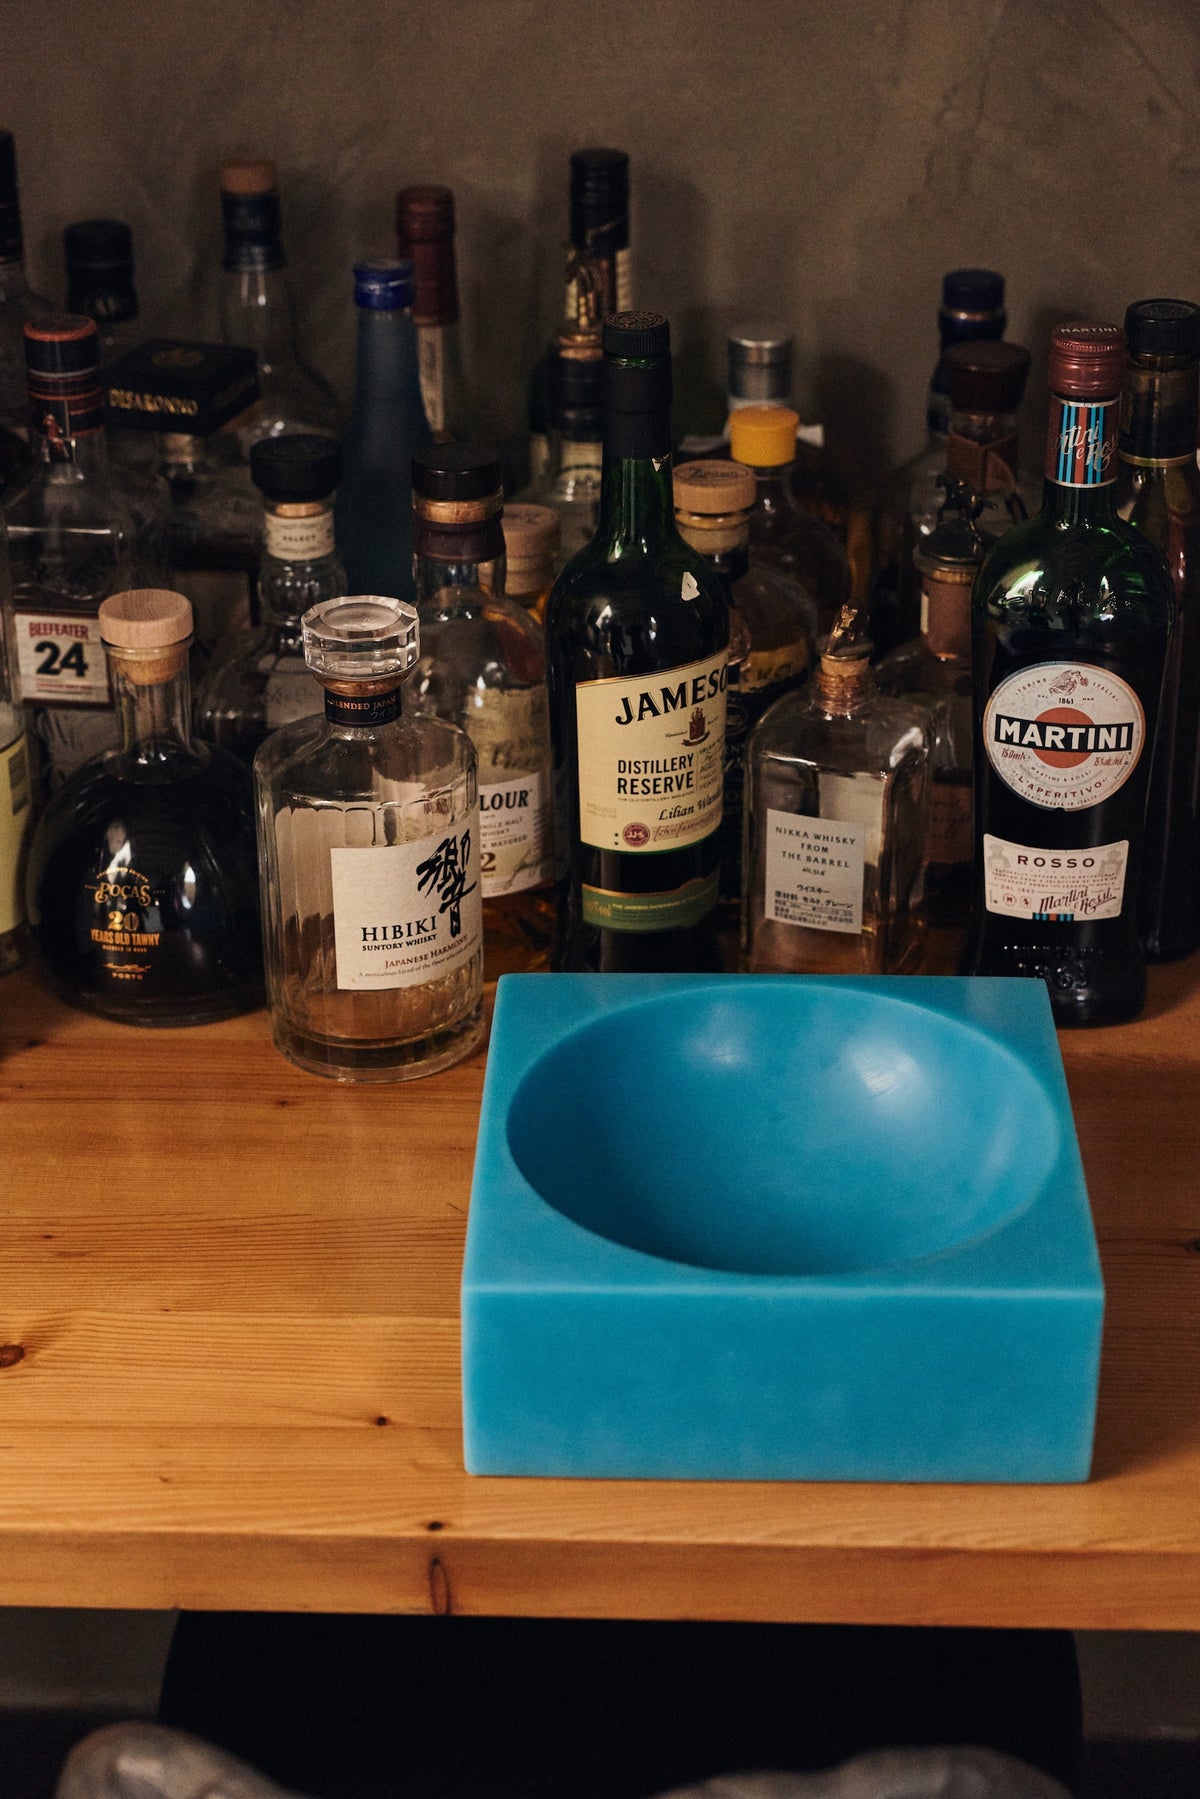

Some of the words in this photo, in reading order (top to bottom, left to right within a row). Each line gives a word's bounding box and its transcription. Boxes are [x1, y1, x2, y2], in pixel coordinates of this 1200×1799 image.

[1060, 326, 1119, 334] MARTINI
[29, 622, 89, 640] BEEFEATER
[34, 640, 89, 678] 24
[1016, 677, 1048, 695] TORINO
[1092, 681, 1118, 700] ITALIA
[331, 699, 371, 711] LENDED
[1058, 696, 1075, 705] 1863
[999, 718, 1129, 750] MARTINI
[617, 753, 694, 776] DISTILLERY
[1030, 766, 1060, 782] MARTINI
[617, 771, 694, 795] RESERVE
[1018, 776, 1102, 799] L'APERITIVO
[658, 803, 695, 821] Lilian
[775, 827, 809, 839] NIKKA
[813, 833, 856, 845] WHISKY
[800, 843, 829, 853] FROM
[781, 851, 802, 861] THE
[806, 855, 850, 868] BARREL
[1017, 855, 1096, 868] ROSSO
[95, 881, 152, 907] POÇAS
[796, 884, 831, 894] ウイスキー
[1039, 886, 1088, 914] Martini
[107, 910, 140, 932] 20
[361, 914, 438, 942] HIBIKI
[90, 928, 114, 945] YEARS
[114, 931, 131, 946] OLD
[131, 933, 160, 947] TAWNY
[362, 941, 404, 952] SUNTORY
[405, 932, 438, 948] WHISKY
[430, 934, 468, 958] HARMONY
